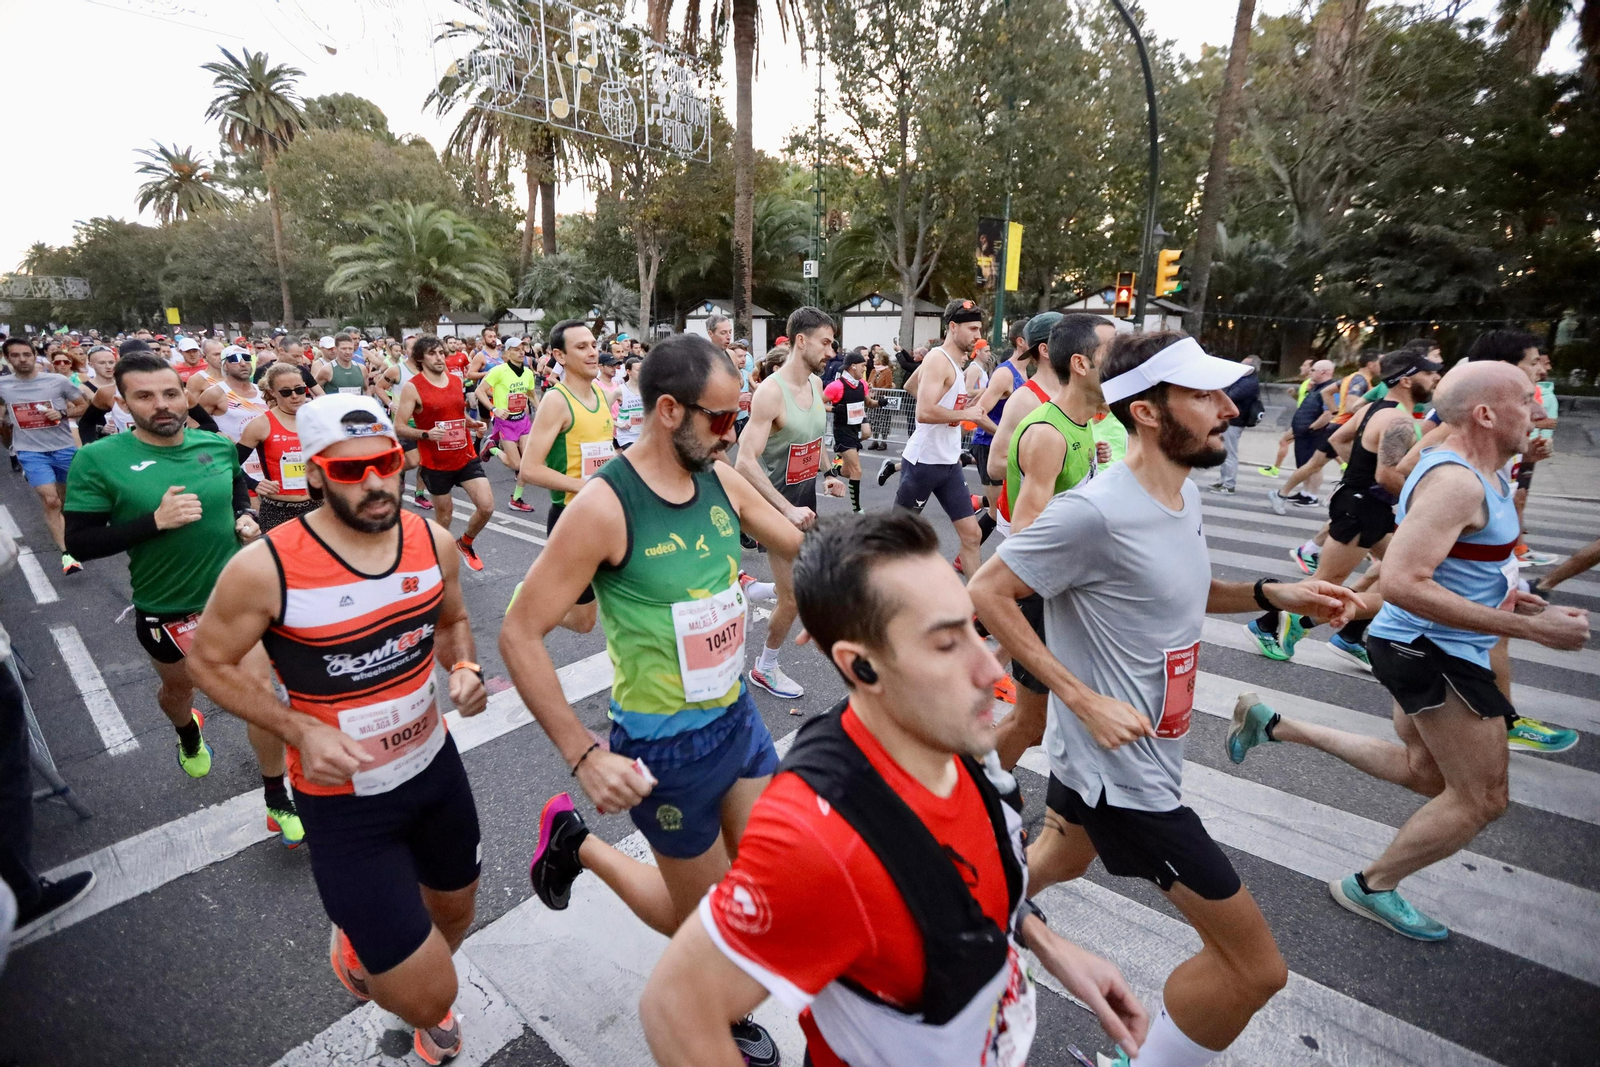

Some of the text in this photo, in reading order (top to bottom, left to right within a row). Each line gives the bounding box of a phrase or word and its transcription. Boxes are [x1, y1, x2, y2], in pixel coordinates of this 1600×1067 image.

[675, 95, 705, 128] FUN
[662, 117, 693, 151] FUN
[262, 496, 311, 508] NIKE PRO
[644, 542, 677, 557] cudeca
[705, 622, 737, 652] 10417
[351, 649, 422, 682] wheelssport.net
[379, 716, 429, 751] 10022
[1518, 730, 1551, 744] HOKA
